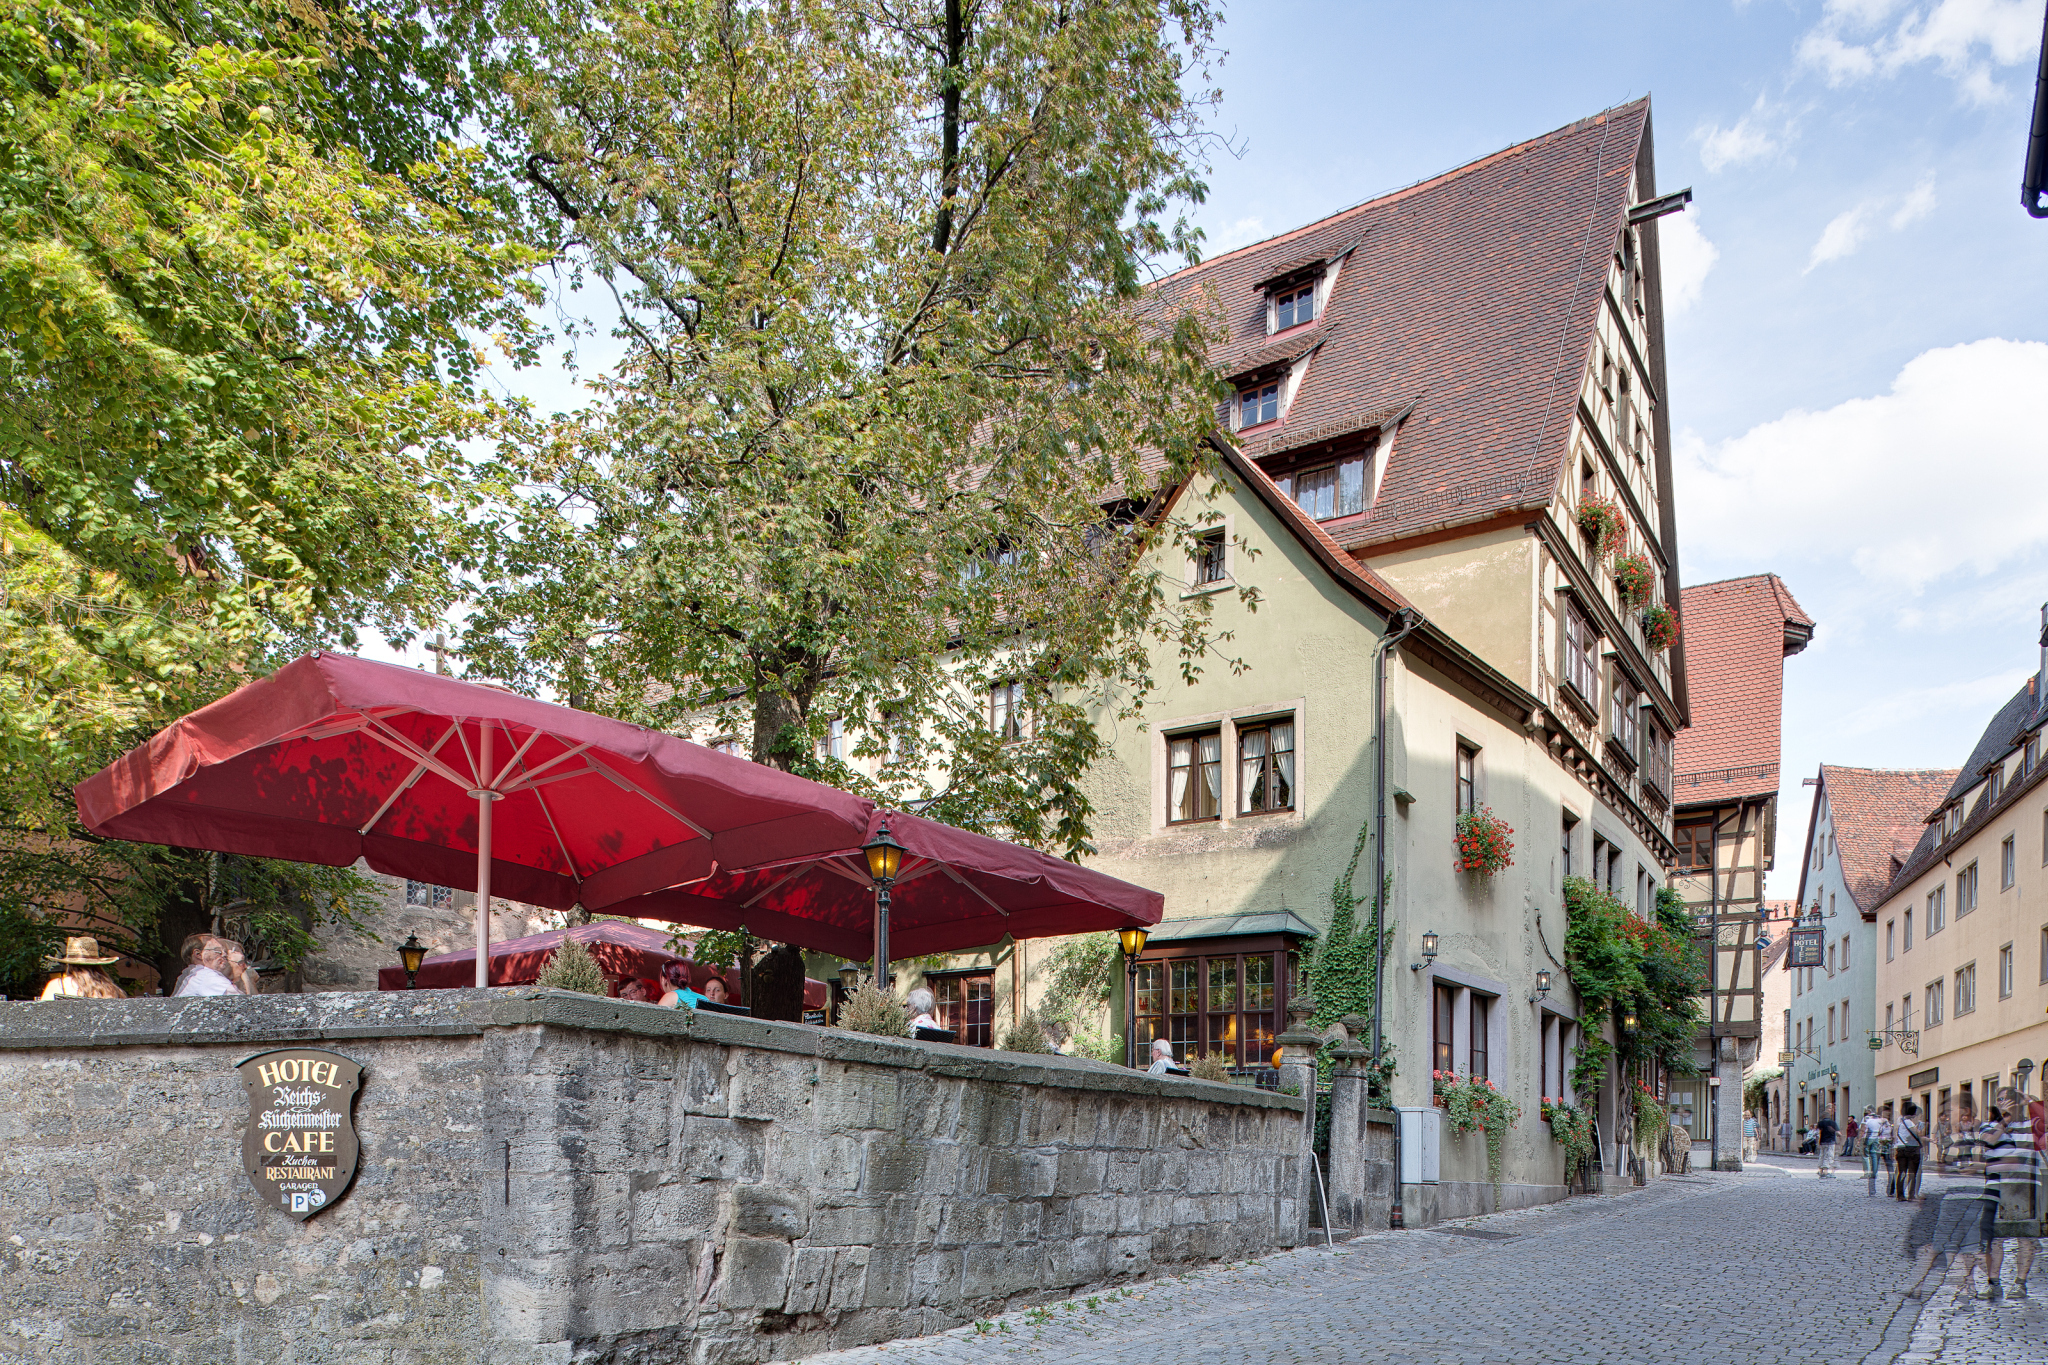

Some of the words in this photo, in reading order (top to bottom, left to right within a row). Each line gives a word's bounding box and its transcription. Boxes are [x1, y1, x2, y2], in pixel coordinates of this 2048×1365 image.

[257, 1059, 342, 1089] HOTEL
[264, 1131, 334, 1153] CAFE
[281, 1155, 318, 1167] Kuchen
[266, 1167, 336, 1181] RESTAURANT
[295, 1195, 305, 1209] P
